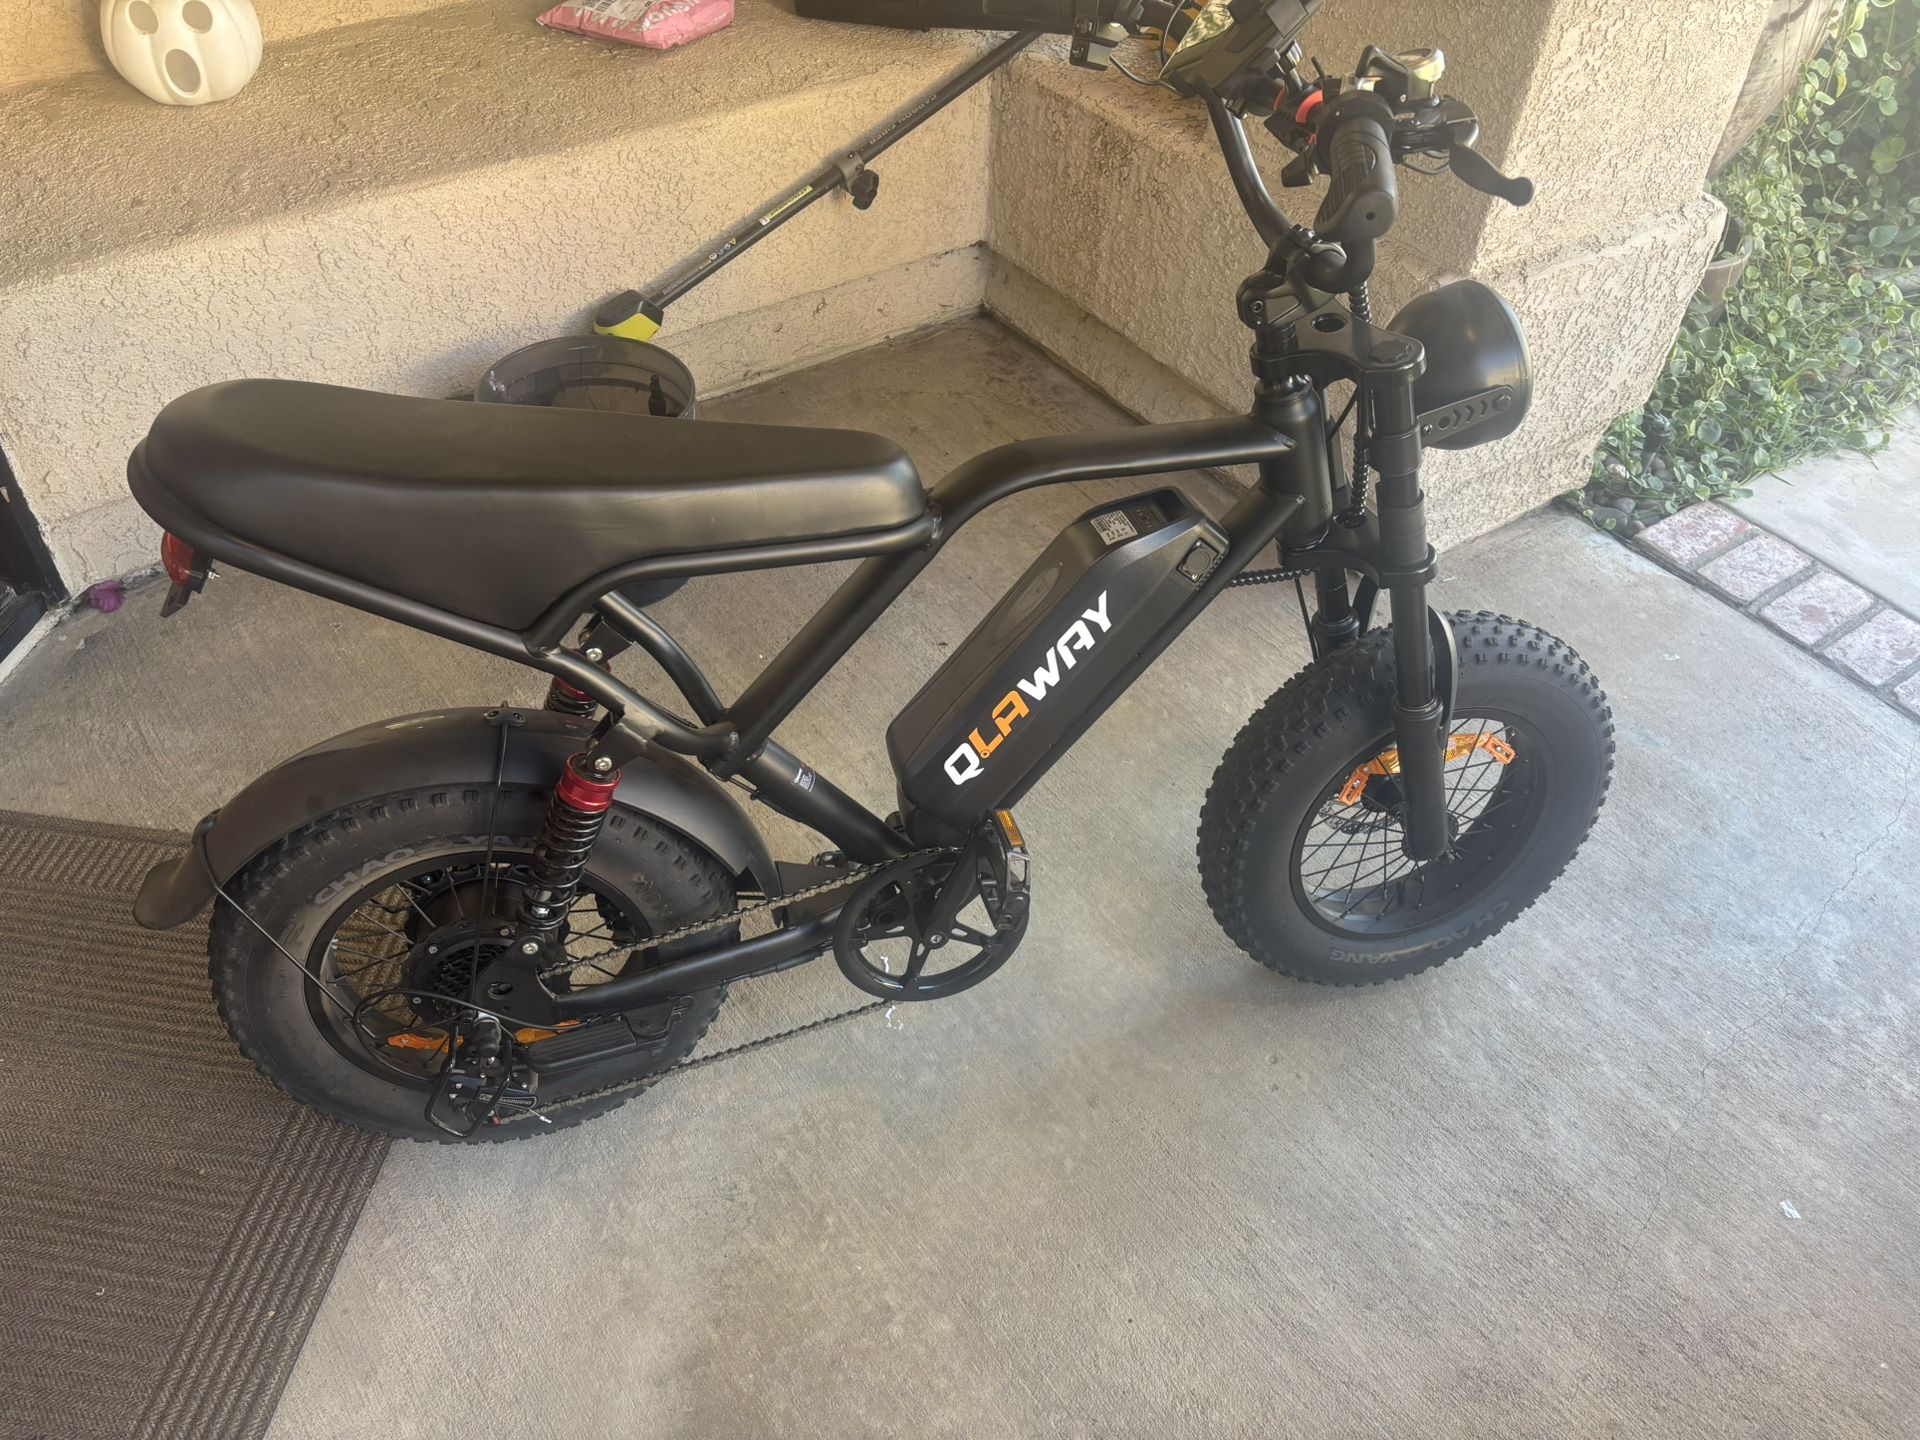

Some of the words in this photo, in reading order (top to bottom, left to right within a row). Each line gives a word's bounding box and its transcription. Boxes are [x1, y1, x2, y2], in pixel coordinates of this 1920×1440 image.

[944, 590, 1112, 785] QLAWAY
[315, 847, 416, 904] CHAO
[1430, 898, 1510, 950] CHAO
[1329, 948, 1399, 965] YANG
